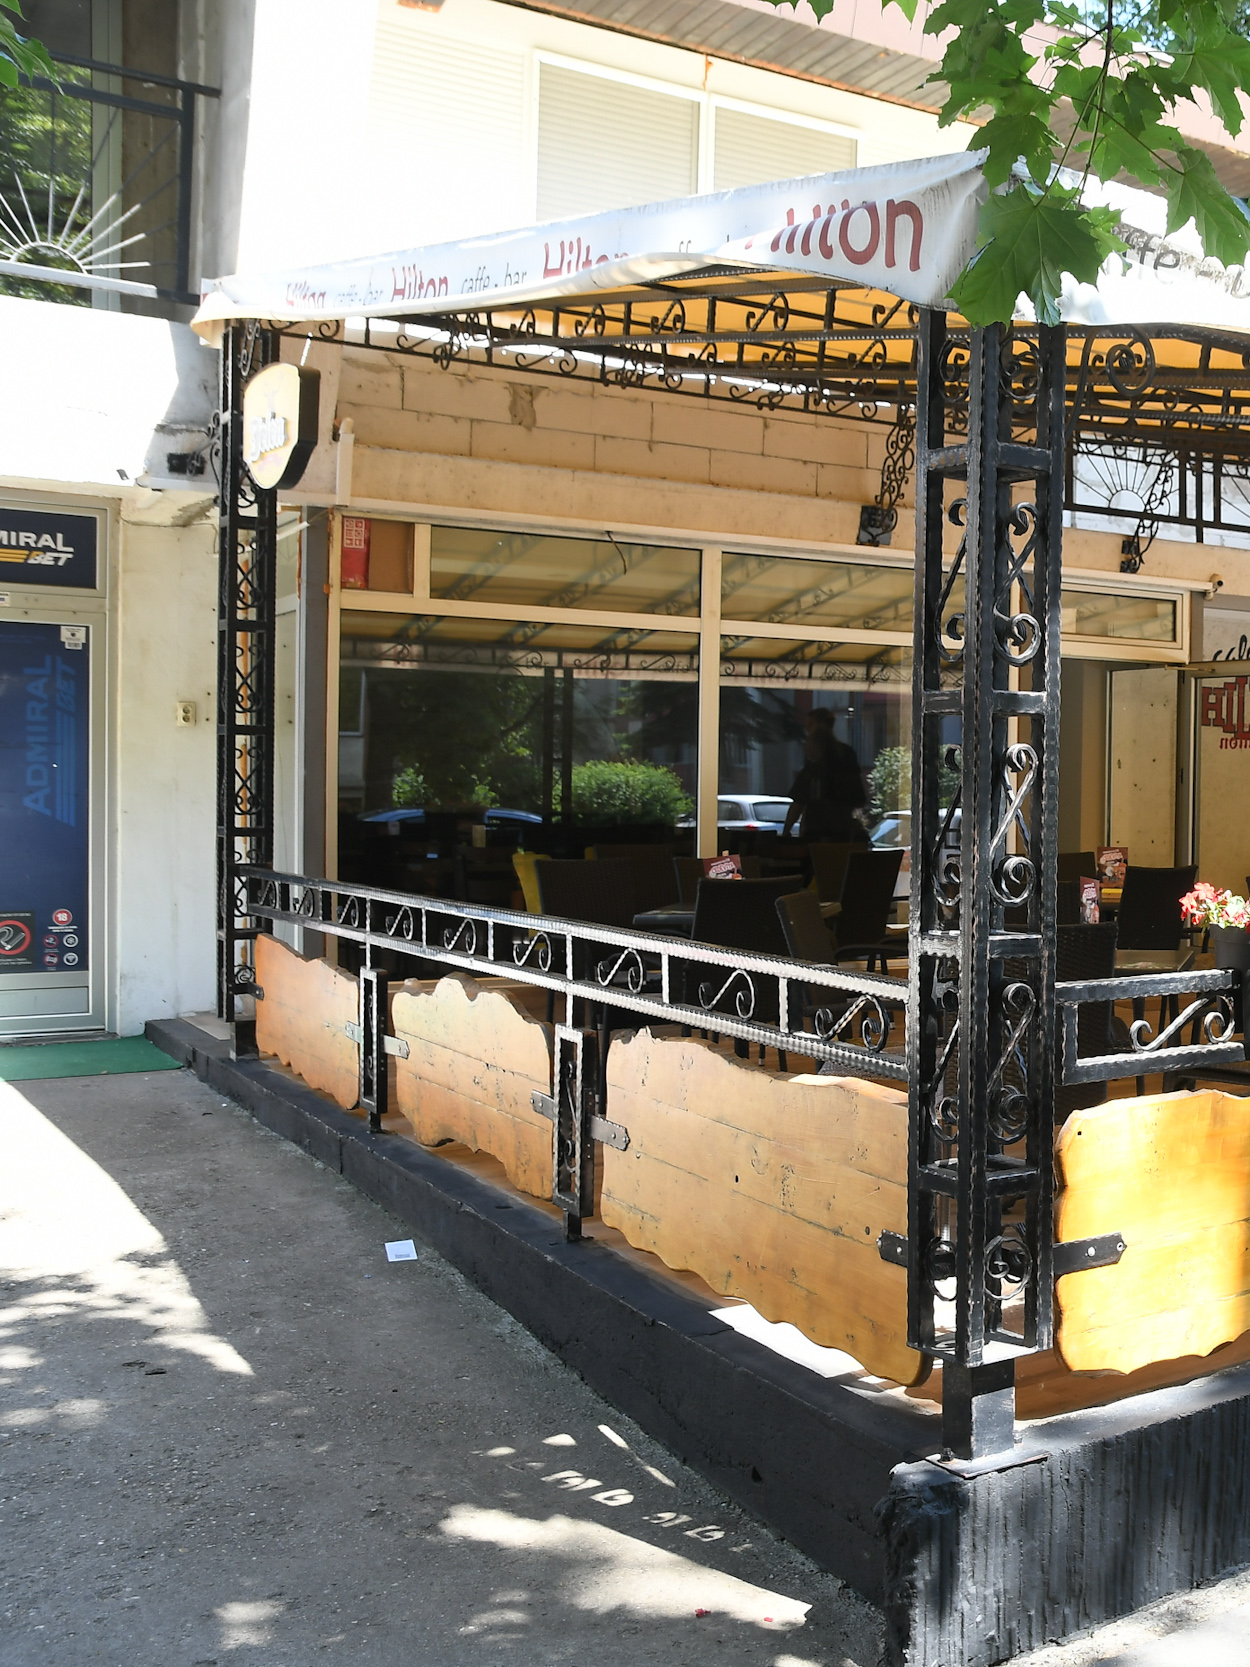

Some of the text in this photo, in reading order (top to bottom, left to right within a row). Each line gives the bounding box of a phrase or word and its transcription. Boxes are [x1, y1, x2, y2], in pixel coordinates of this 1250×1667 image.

[390, 263, 449, 302] Hilton
[26, 551, 74, 567] BET
[23, 654, 52, 816] ADMIRAL
[56, 912, 69, 922] 18
